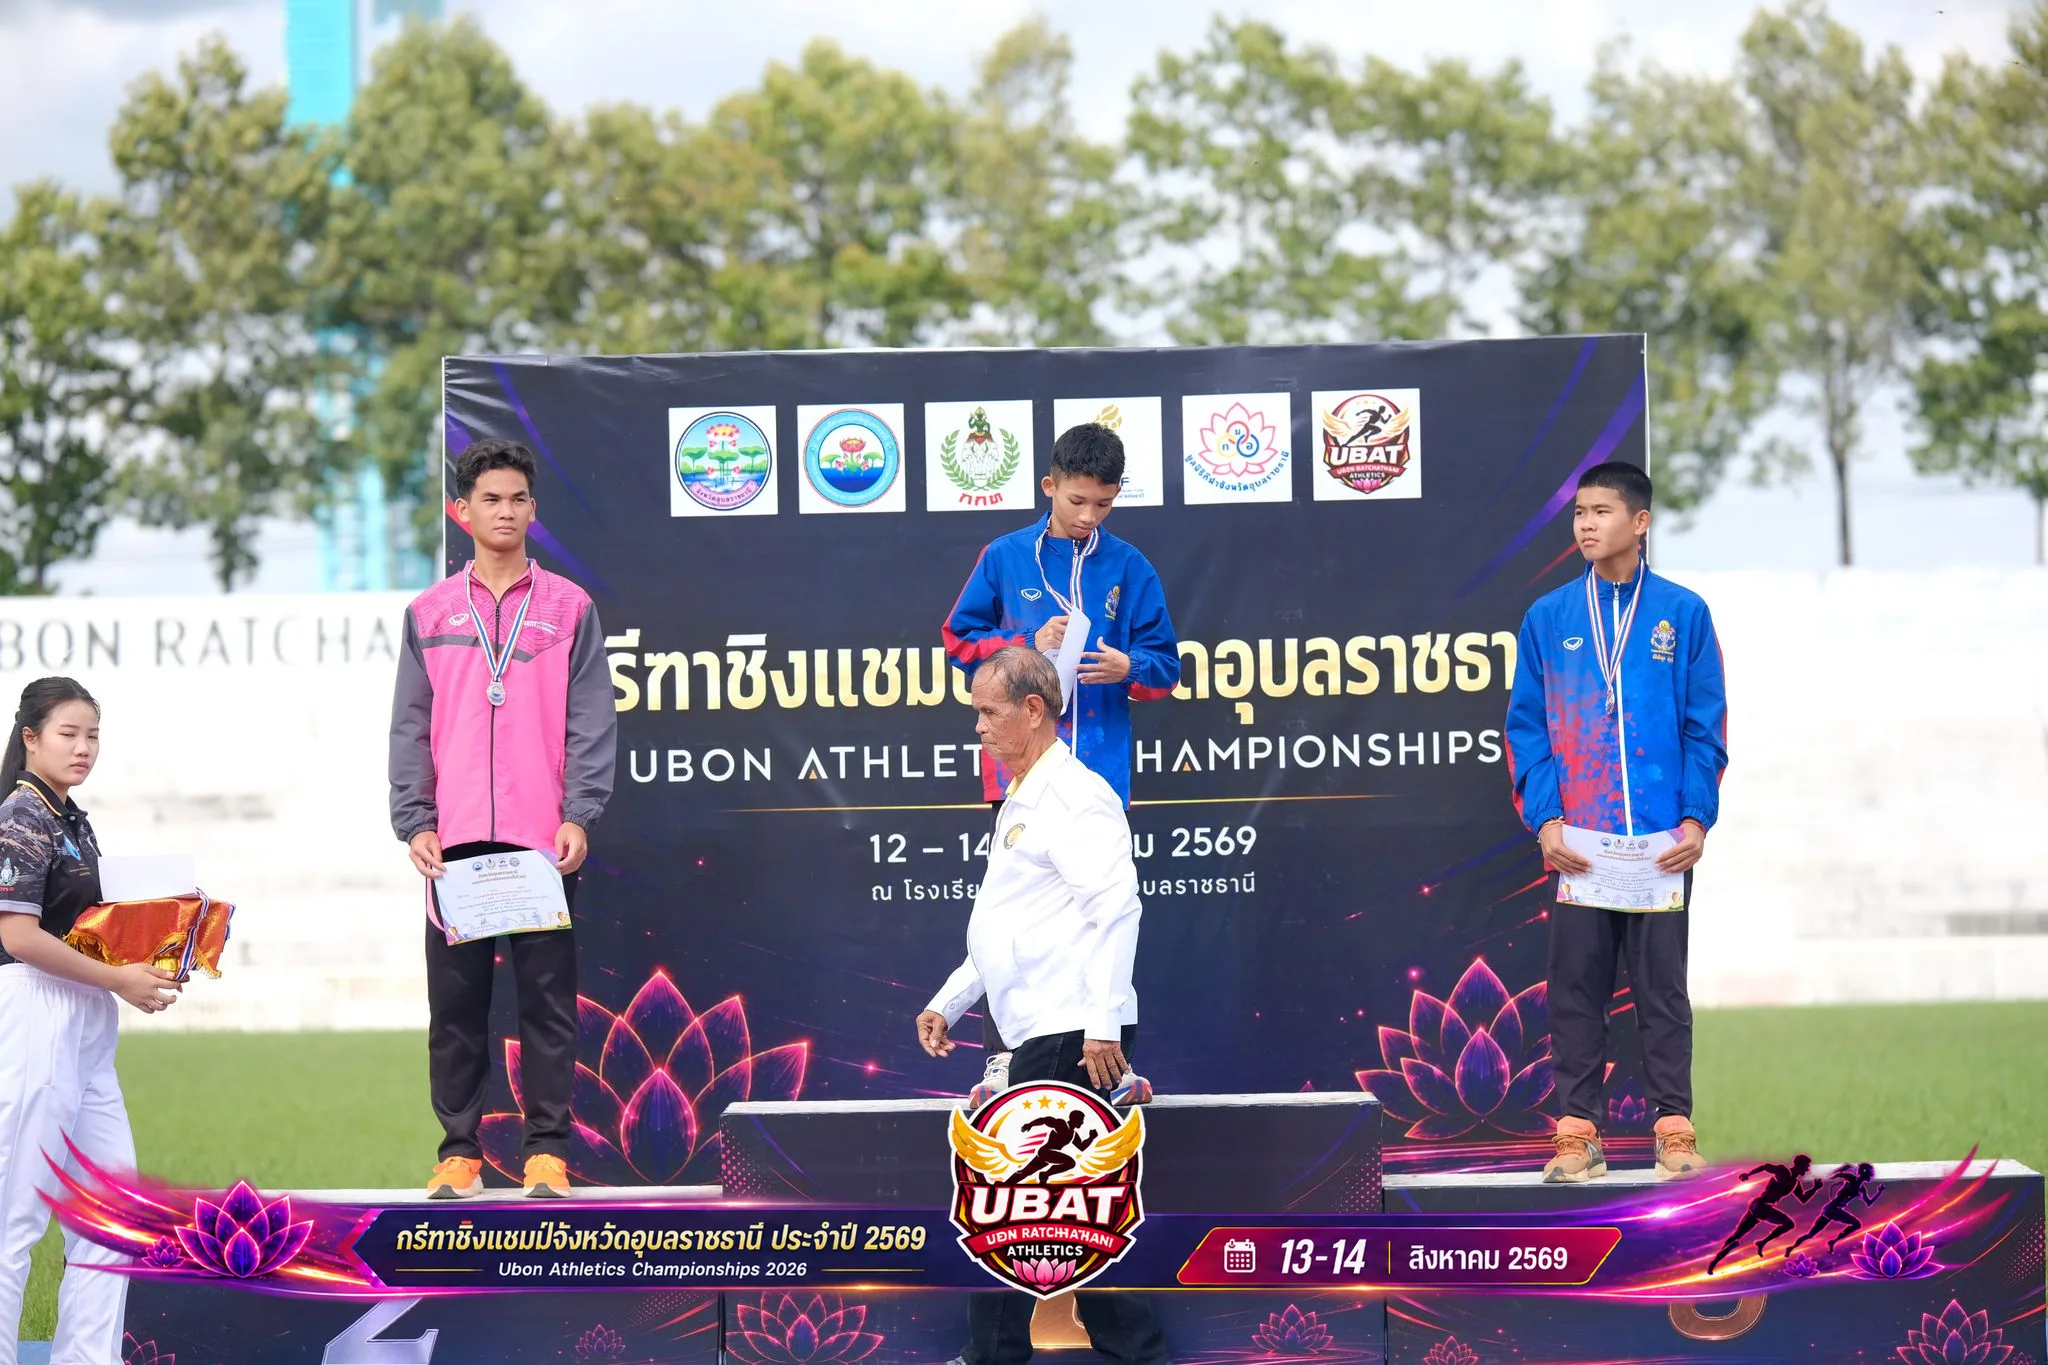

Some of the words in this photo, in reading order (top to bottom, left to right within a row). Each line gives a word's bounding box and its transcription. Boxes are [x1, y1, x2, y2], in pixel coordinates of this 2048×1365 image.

[1329, 444, 1404, 466] UBAT
[958, 492, 1004, 506] กกท
[0, 617, 120, 670] BON
[154, 614, 397, 668] RATCHA
[629, 747, 772, 783] UBON
[797, 744, 984, 781] ATHLET
[1135, 729, 1503, 774] HAMPIONSHIPS
[869, 833, 907, 863] 12
[958, 831, 990, 862] 14
[1170, 825, 1257, 858] 2569
[871, 883, 893, 901] ณ
[903, 877, 980, 901] โรงเรีย
[1142, 871, 1256, 896] บลราชธานี
